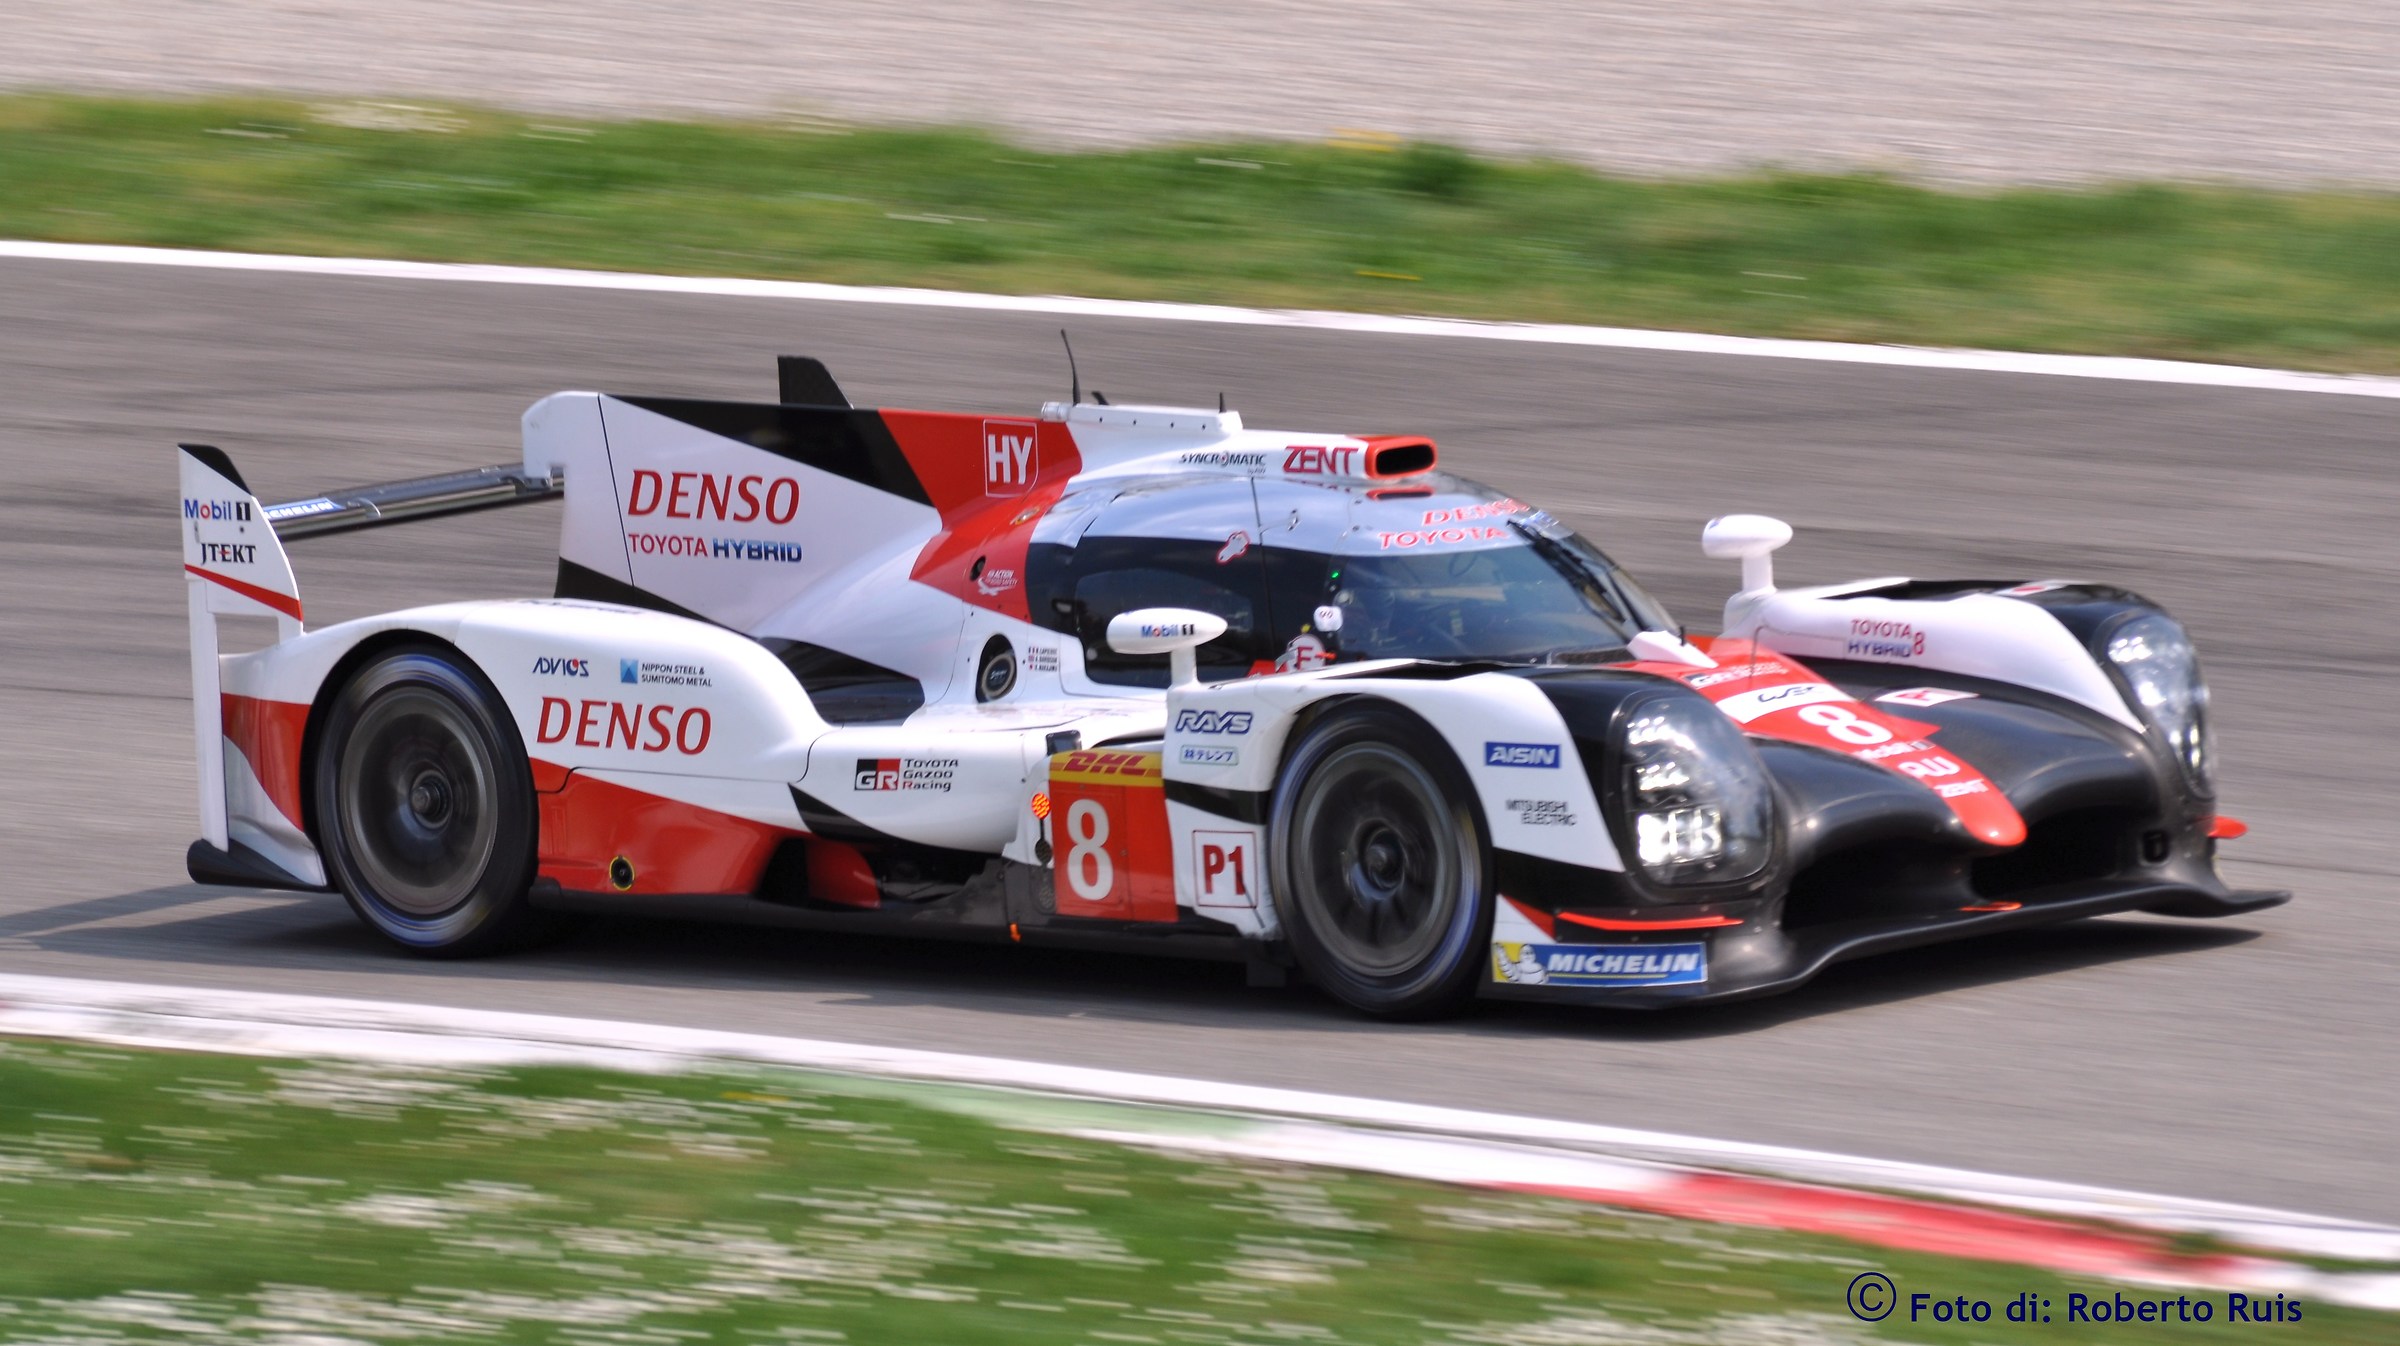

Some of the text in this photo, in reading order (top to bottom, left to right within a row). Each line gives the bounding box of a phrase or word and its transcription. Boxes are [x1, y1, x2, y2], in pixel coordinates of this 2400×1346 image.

[988, 434, 1033, 485] HY
[1283, 445, 1359, 475] ZENT
[628, 469, 800, 525] DENSO
[184, 499, 251, 521] Mobil 1
[628, 533, 802, 563] TOYOTA HYBRID
[1379, 527, 1510, 550] TOYOTA
[201, 542, 257, 564] JTEKT
[1141, 623, 1195, 638] Mobil 1
[1851, 619, 1912, 640] TOYOTA
[1913, 631, 1925, 656] 8
[532, 657, 589, 678] ADVICS
[642, 663, 705, 675] NIPPON STEEL &
[642, 674, 712, 687] SUMITOMO METAL
[537, 696, 712, 756] DENSO
[1175, 709, 1253, 734] RAYS
[1798, 705, 1892, 744] 8
[904, 758, 959, 769] TOYOTA
[1063, 751, 1145, 776] DHL
[1489, 746, 1556, 765] AISIN
[855, 771, 899, 789] GR
[903, 770, 953, 780] GAZOO
[902, 781, 951, 793] Racing
[1067, 799, 1114, 901] 8
[1203, 845, 1246, 895] P1
[1547, 953, 1700, 973] MICHELIN
